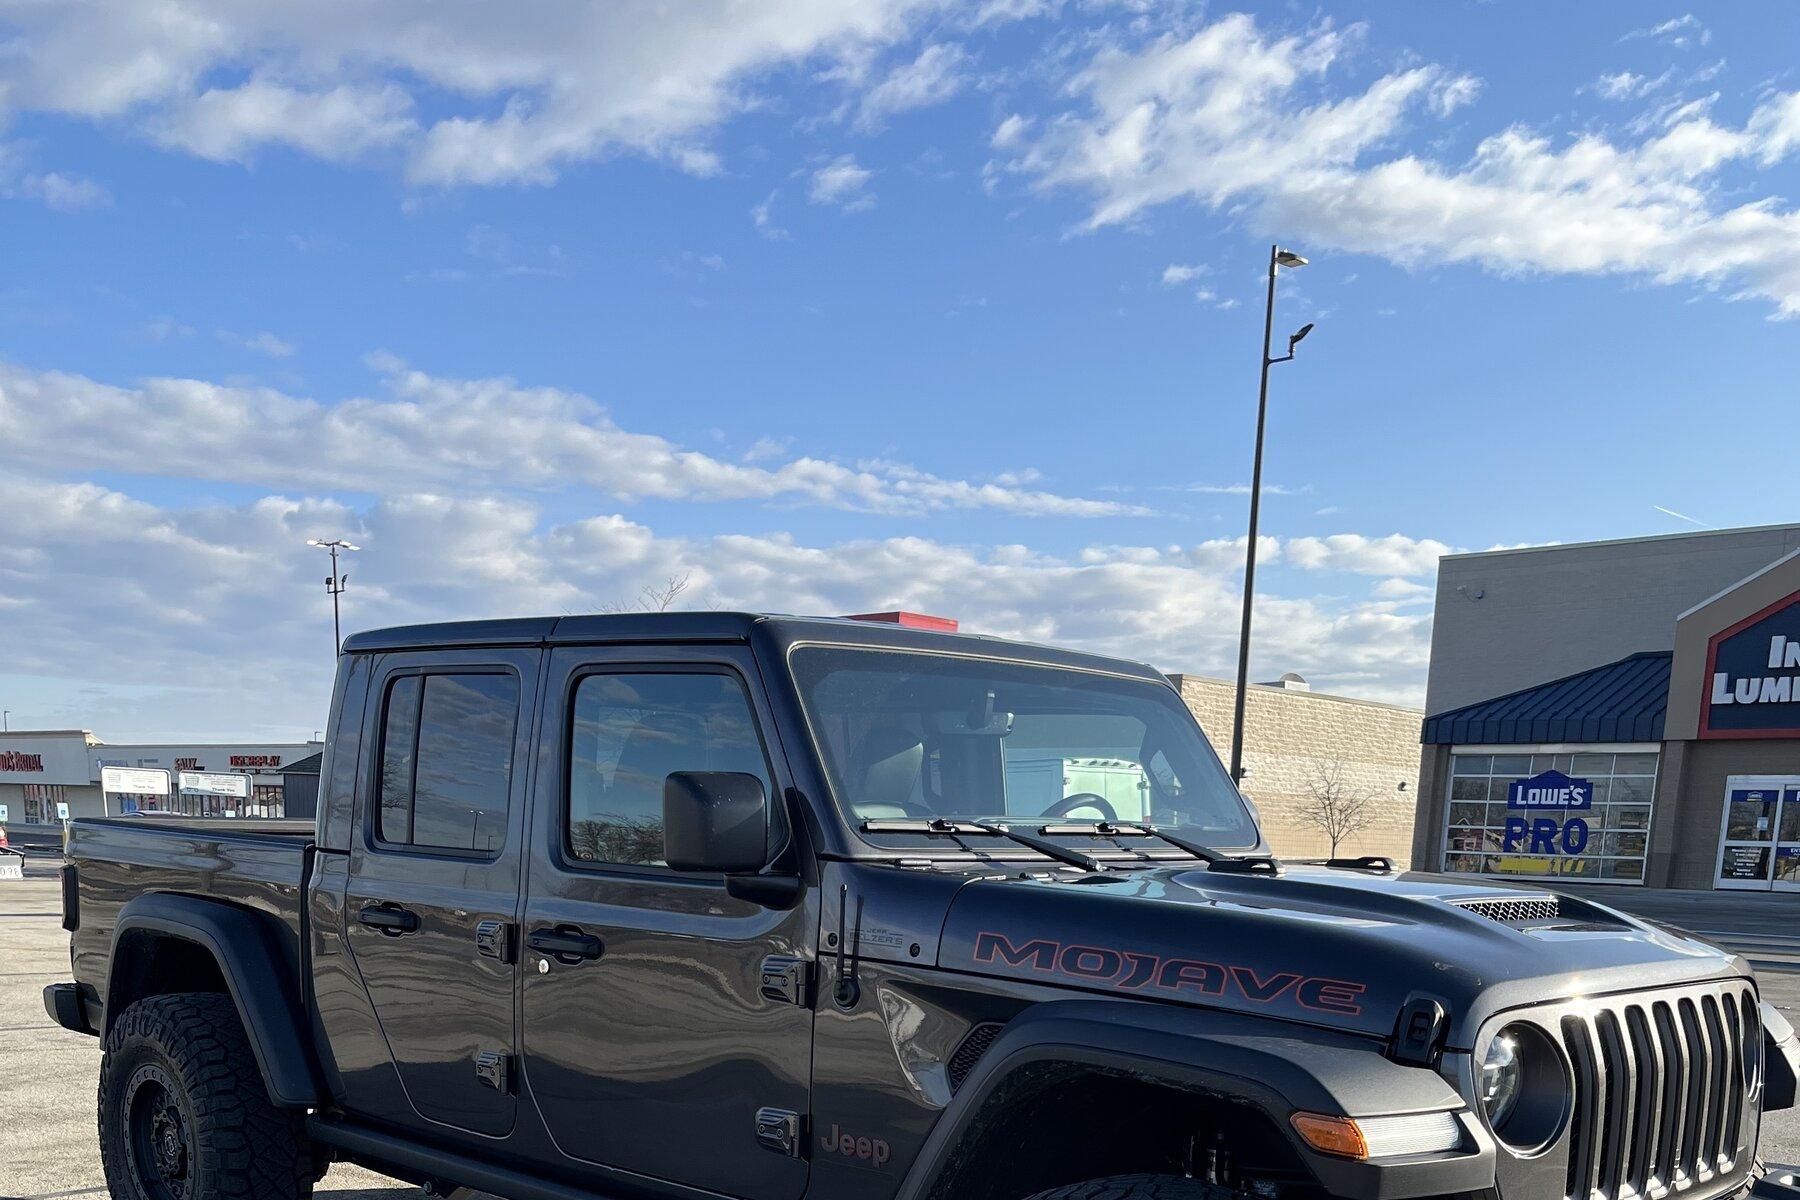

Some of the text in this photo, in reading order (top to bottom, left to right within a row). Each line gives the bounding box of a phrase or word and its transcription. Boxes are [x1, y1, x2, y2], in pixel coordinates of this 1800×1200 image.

[1516, 785, 1584, 805] LOWE'S
[1503, 818, 1588, 855] PRO
[974, 931, 1367, 1016] MOJAVE
[820, 1124, 891, 1168] Jeep
